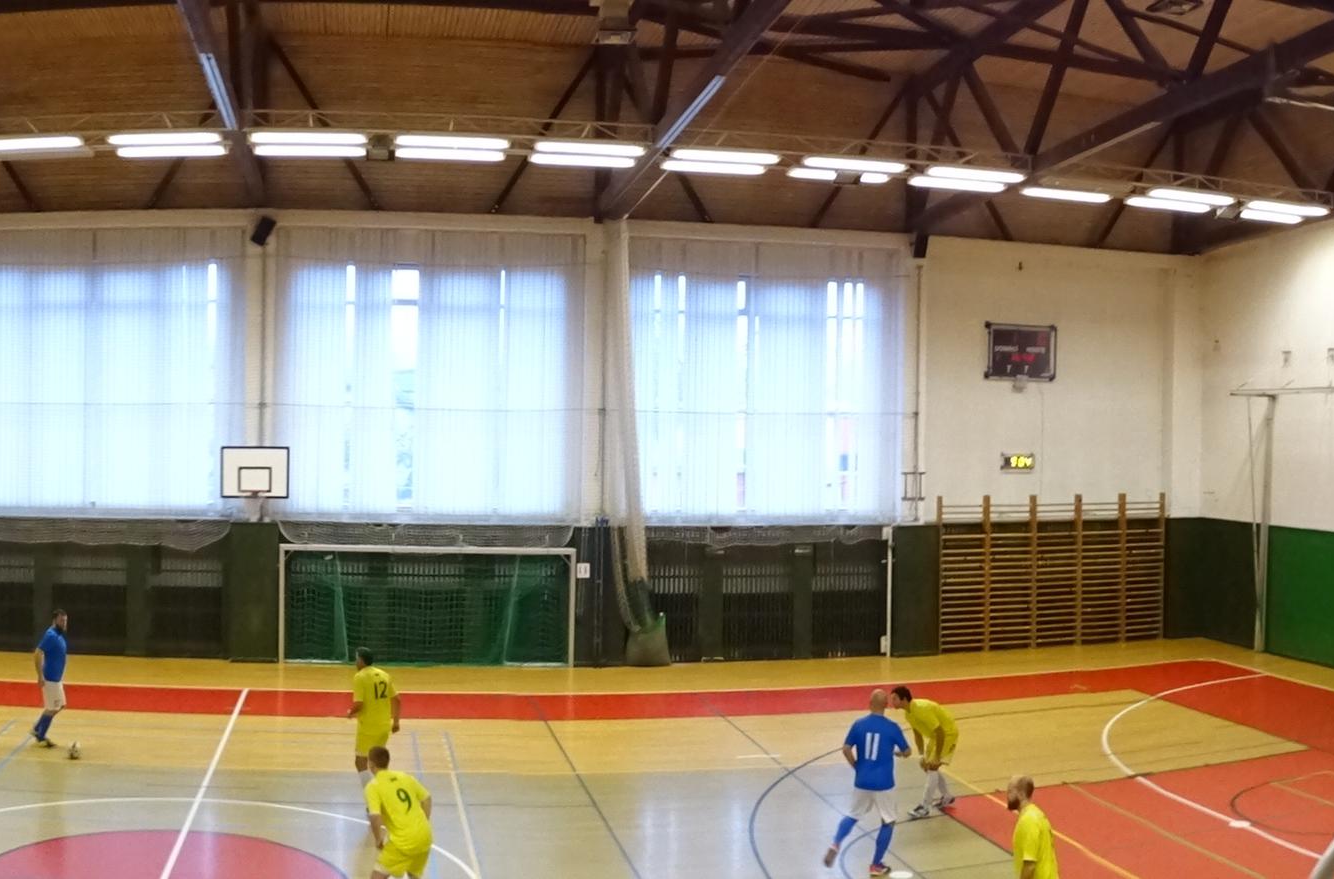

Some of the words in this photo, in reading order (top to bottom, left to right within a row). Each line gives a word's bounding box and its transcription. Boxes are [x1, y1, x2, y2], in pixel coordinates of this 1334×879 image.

[374, 681, 387, 700] 12
[865, 732, 880, 761] 11
[396, 788, 412, 815] 9
